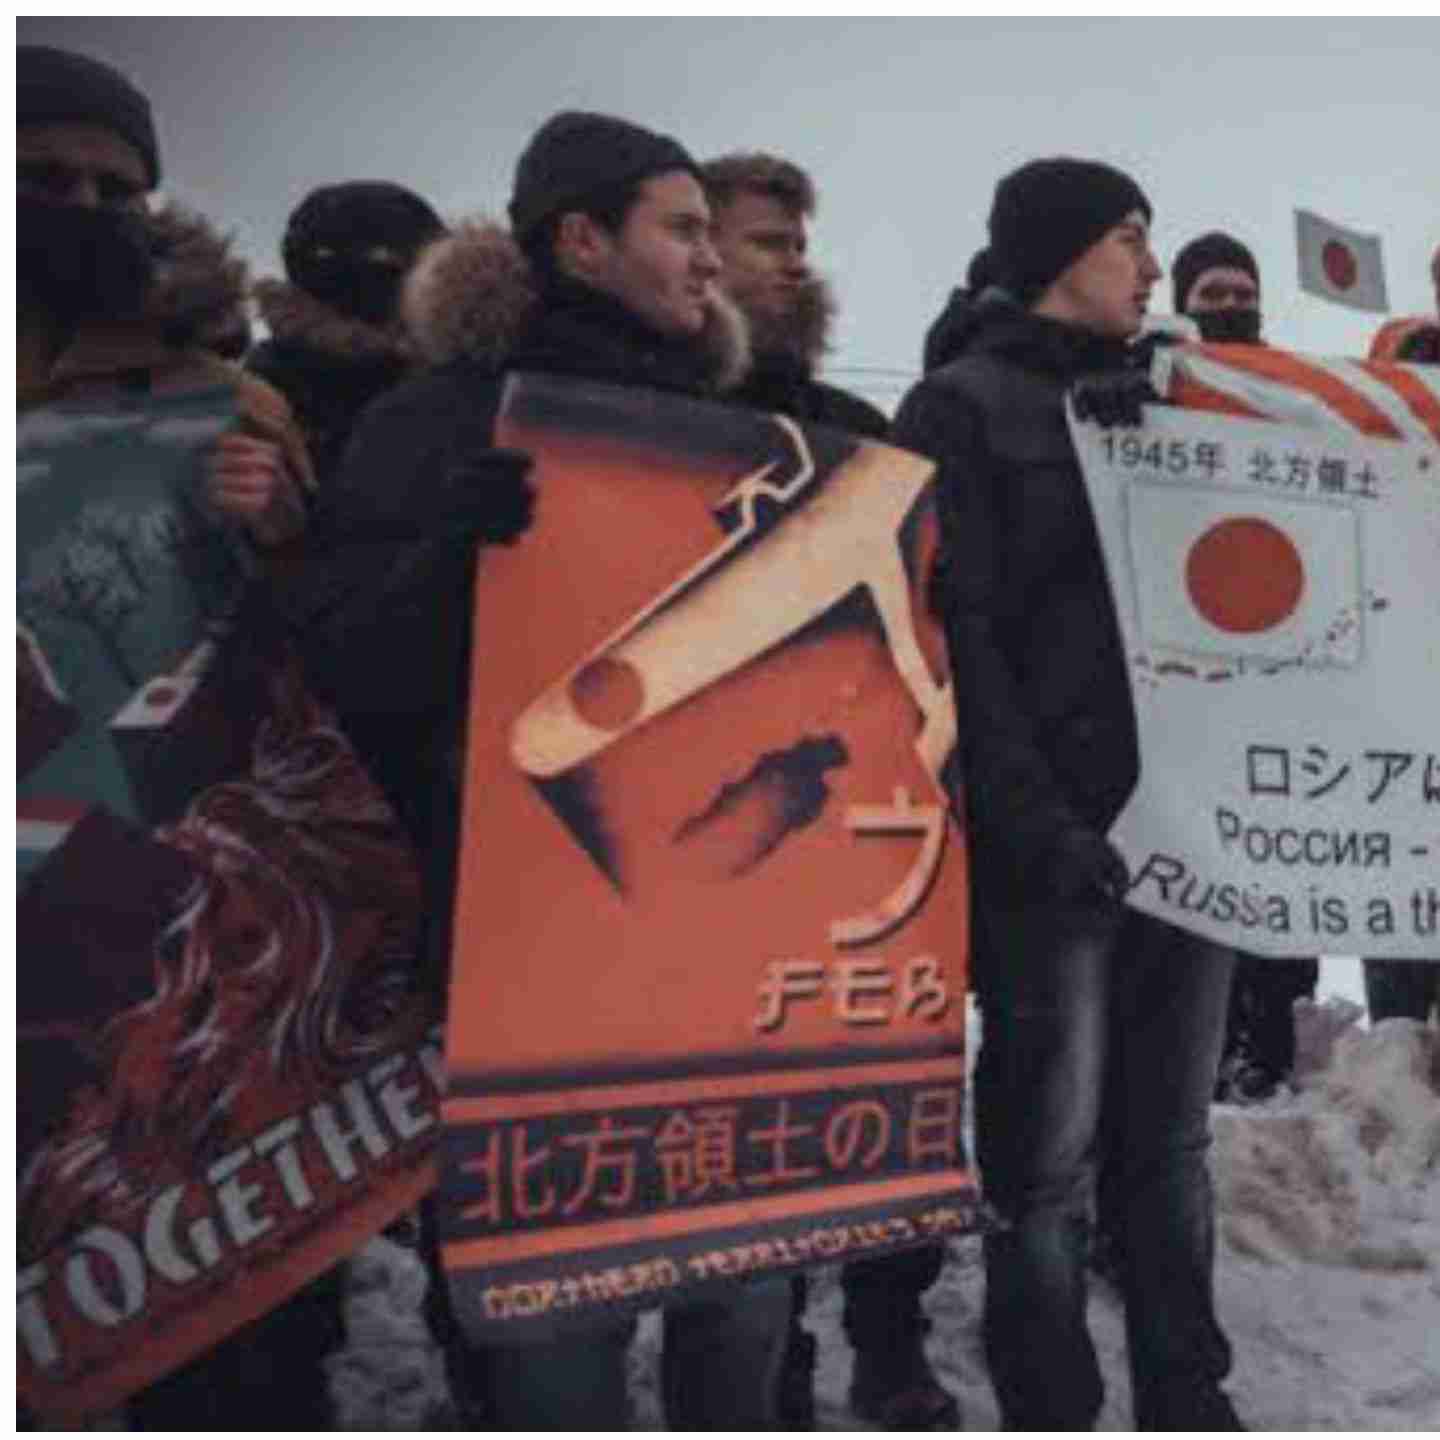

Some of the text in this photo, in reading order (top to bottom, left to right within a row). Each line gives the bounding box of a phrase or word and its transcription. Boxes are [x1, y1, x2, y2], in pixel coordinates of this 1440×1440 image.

[1101, 434, 1381, 499] 1945年 北方領土
[1214, 805, 1392, 868] Россия
[1127, 852, 1291, 934] Russa
[1309, 885, 1349, 936] is
[1366, 896, 1395, 936] a
[459, 1088, 962, 1226] 北方領土の日
